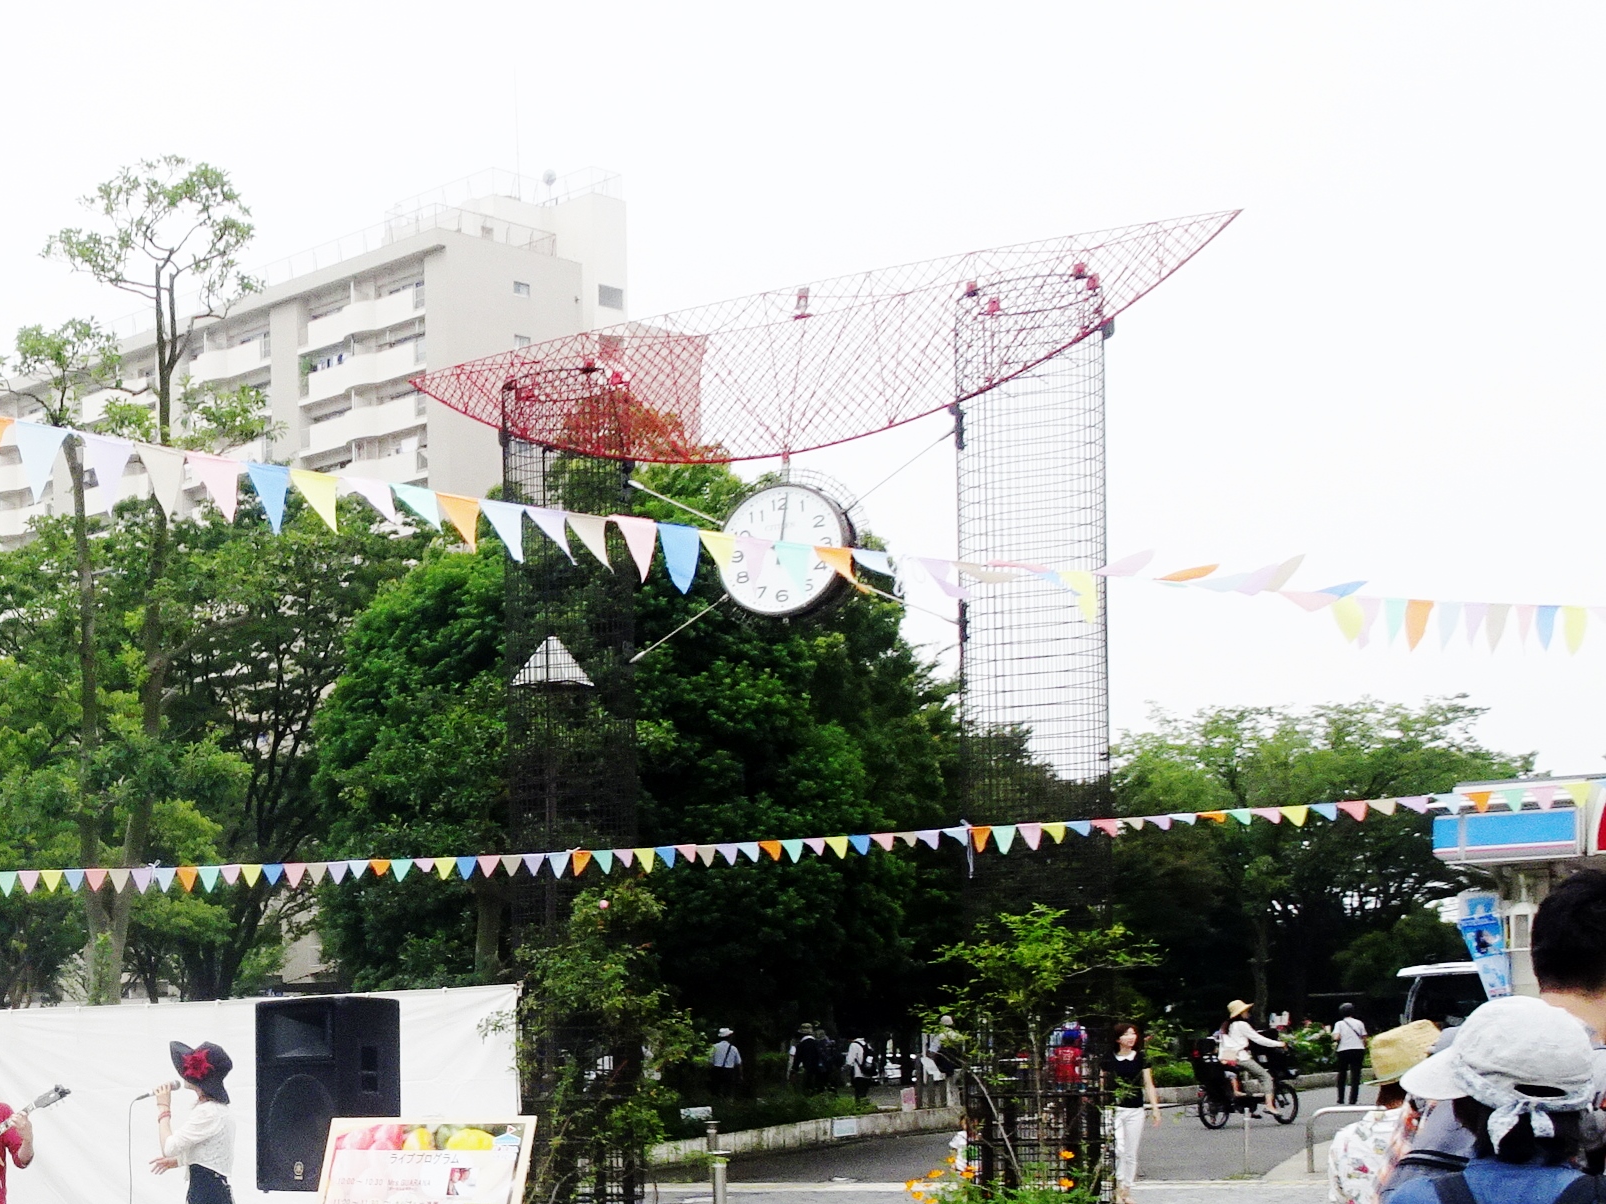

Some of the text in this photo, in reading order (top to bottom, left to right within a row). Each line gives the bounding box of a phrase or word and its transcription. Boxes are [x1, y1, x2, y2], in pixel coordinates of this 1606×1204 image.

[772, 497, 787, 511] 12
[749, 510, 764, 523] 11
[813, 515, 825, 528] 2
[732, 550, 744, 563] 9
[814, 560, 827, 571] 4
[736, 571, 750, 584] 8
[805, 578, 814, 592] 5
[757, 586, 767, 599] 7
[775, 589, 789, 602] 6
[390, 1153, 459, 1165] ライブプログラム
